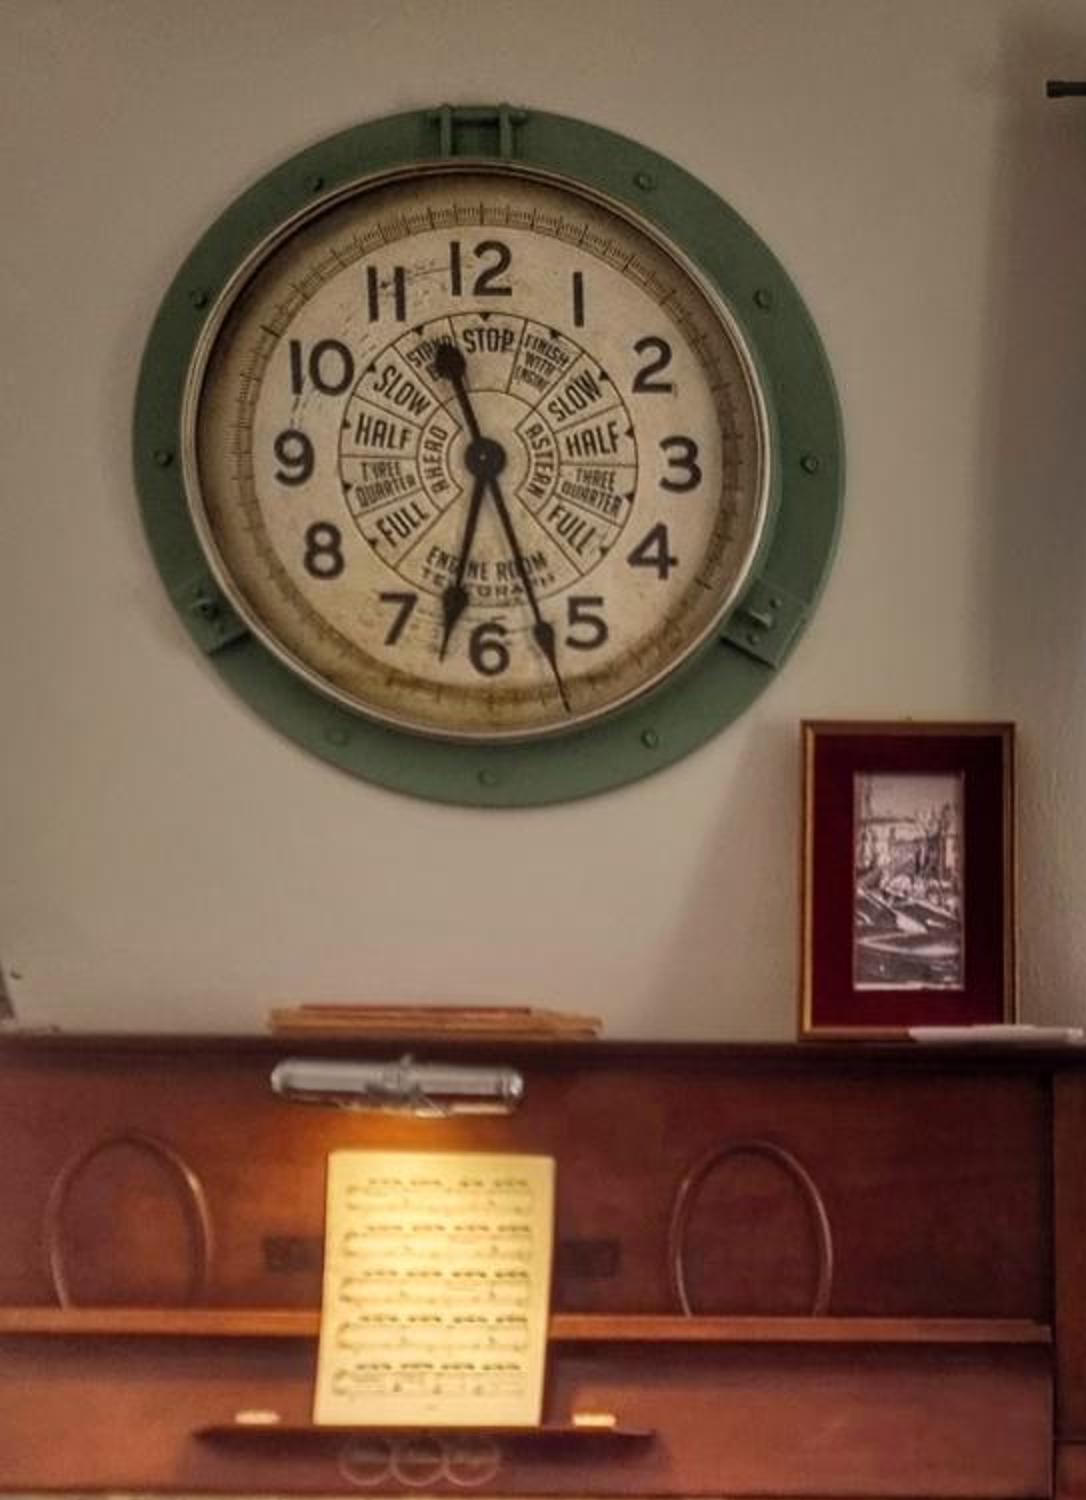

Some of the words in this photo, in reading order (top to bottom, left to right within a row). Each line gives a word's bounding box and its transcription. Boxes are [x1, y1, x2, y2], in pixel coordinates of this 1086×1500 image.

[366, 265, 406, 323] 11
[450, 241, 512, 297] 12
[572, 271, 585, 328] 1
[289, 337, 355, 397] 10
[462, 328, 515, 353] STOP
[631, 335, 673, 395] 2
[373, 365, 431, 417] SLOW
[547, 369, 602, 422] SLOW
[273, 429, 315, 487] 9
[354, 411, 413, 450] HALF
[565, 421, 619, 458] HALF
[422, 425, 451, 494] AHEAD
[525, 423, 554, 498] ASTERN
[576, 467, 616, 493] THREE
[658, 435, 702, 494] 3
[355, 474, 418, 508] QUARTER
[561, 480, 623, 519] QUARTER
[302, 521, 345, 580] 8
[376, 501, 430, 548] FULL
[547, 504, 597, 557] FULL
[626, 521, 679, 581] 4
[426, 545, 487, 581] ENGNE
[377, 592, 418, 646] 7
[564, 596, 609, 651] 5
[469, 621, 511, 677] 6
